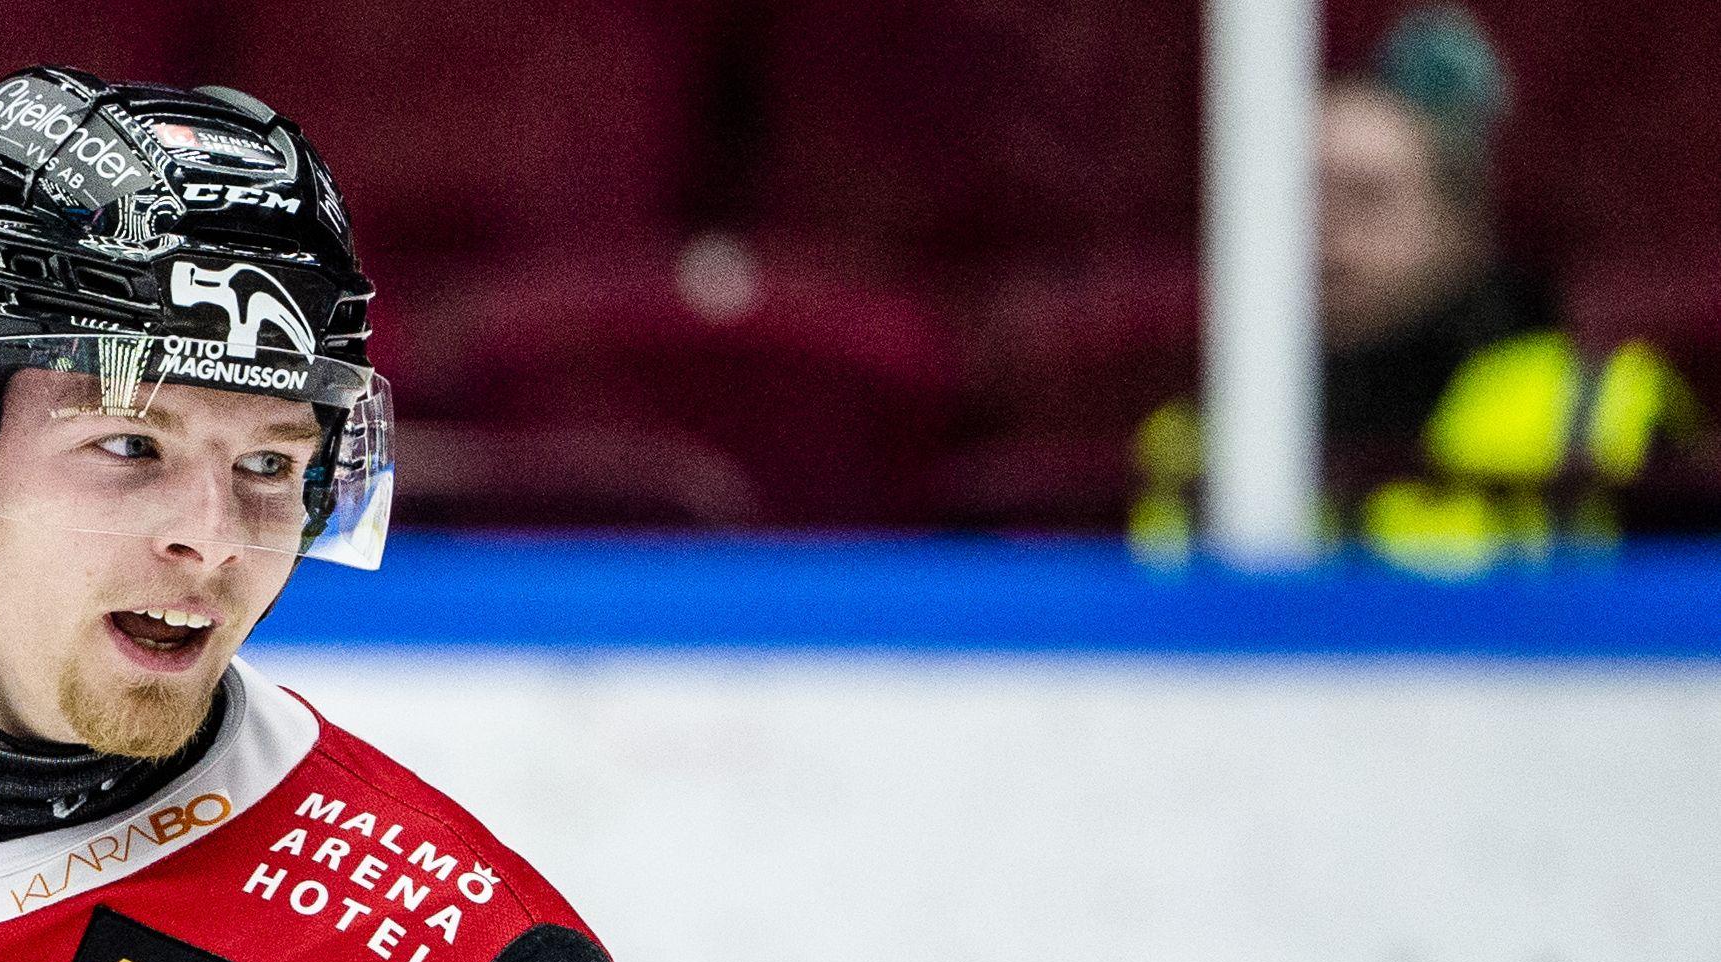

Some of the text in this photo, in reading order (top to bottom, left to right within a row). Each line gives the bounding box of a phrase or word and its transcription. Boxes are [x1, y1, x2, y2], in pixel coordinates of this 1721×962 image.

[197, 132, 276, 155] SVENSKA
[57, 168, 85, 189] AB
[182, 183, 301, 214] CCM
[163, 334, 225, 360] OTTO
[157, 352, 308, 391] MAGNUSSON
[293, 791, 501, 905] MALMÖ
[270, 828, 463, 945] ARENA
